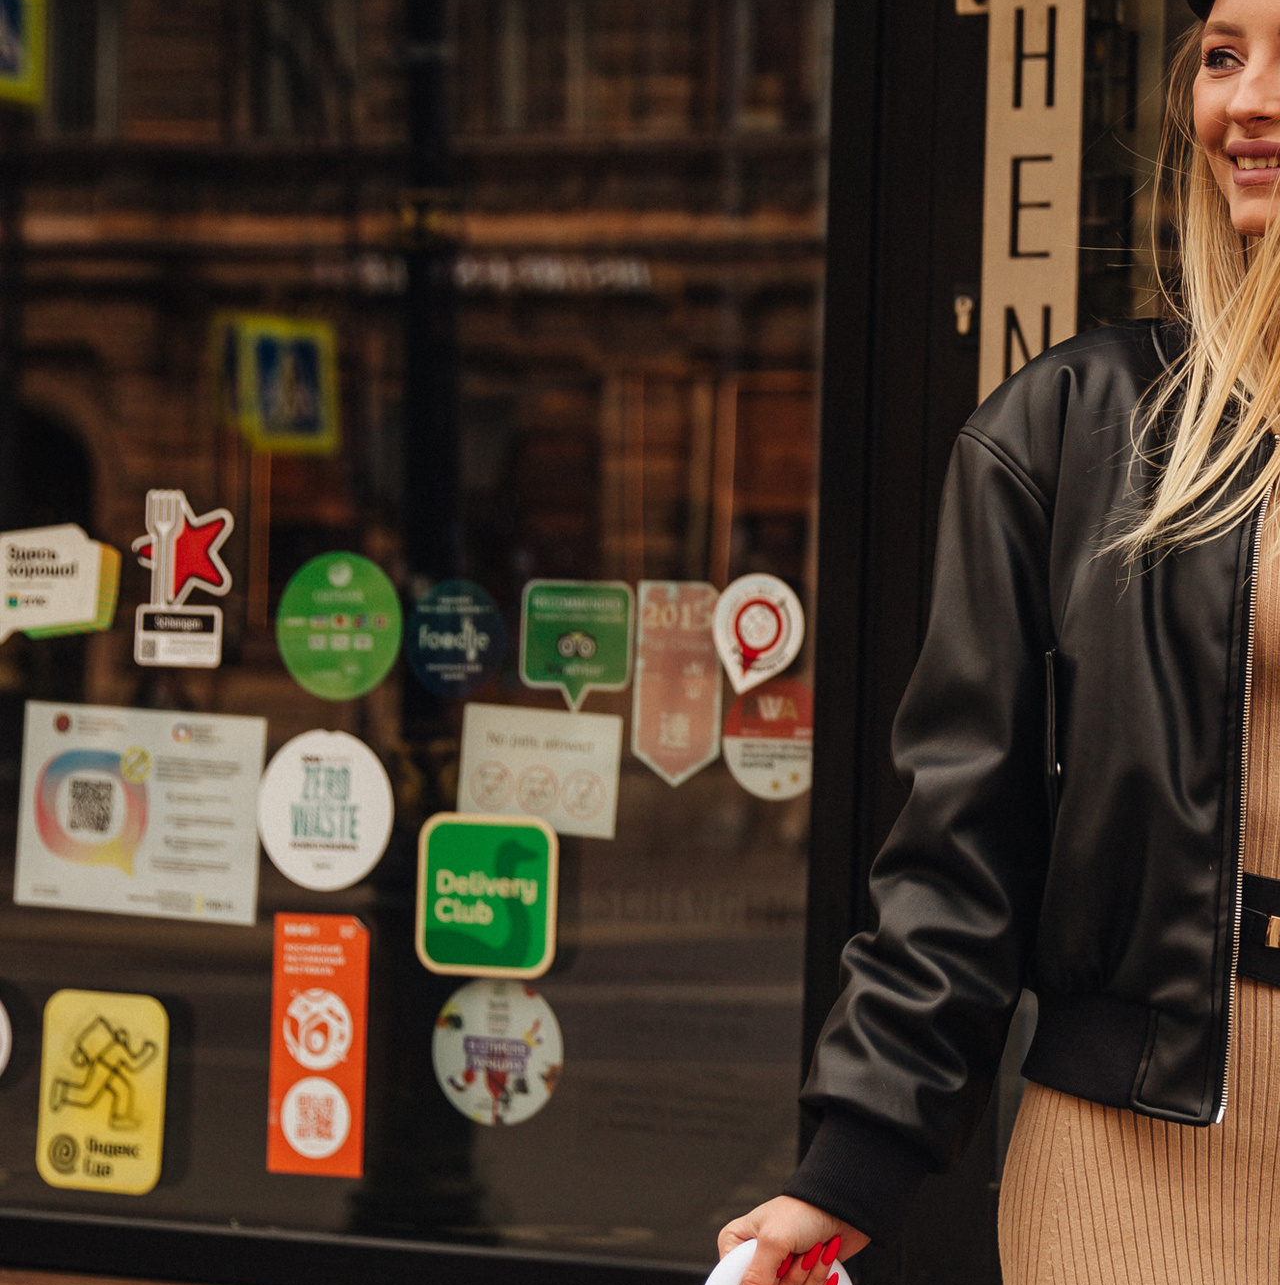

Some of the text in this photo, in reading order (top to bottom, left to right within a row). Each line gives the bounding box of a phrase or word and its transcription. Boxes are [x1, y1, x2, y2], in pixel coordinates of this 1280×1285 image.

[301, 766, 351, 801] ZERO
[291, 802, 360, 840] WASTE
[436, 869, 538, 905] Delivery
[434, 897, 494, 926] Club
